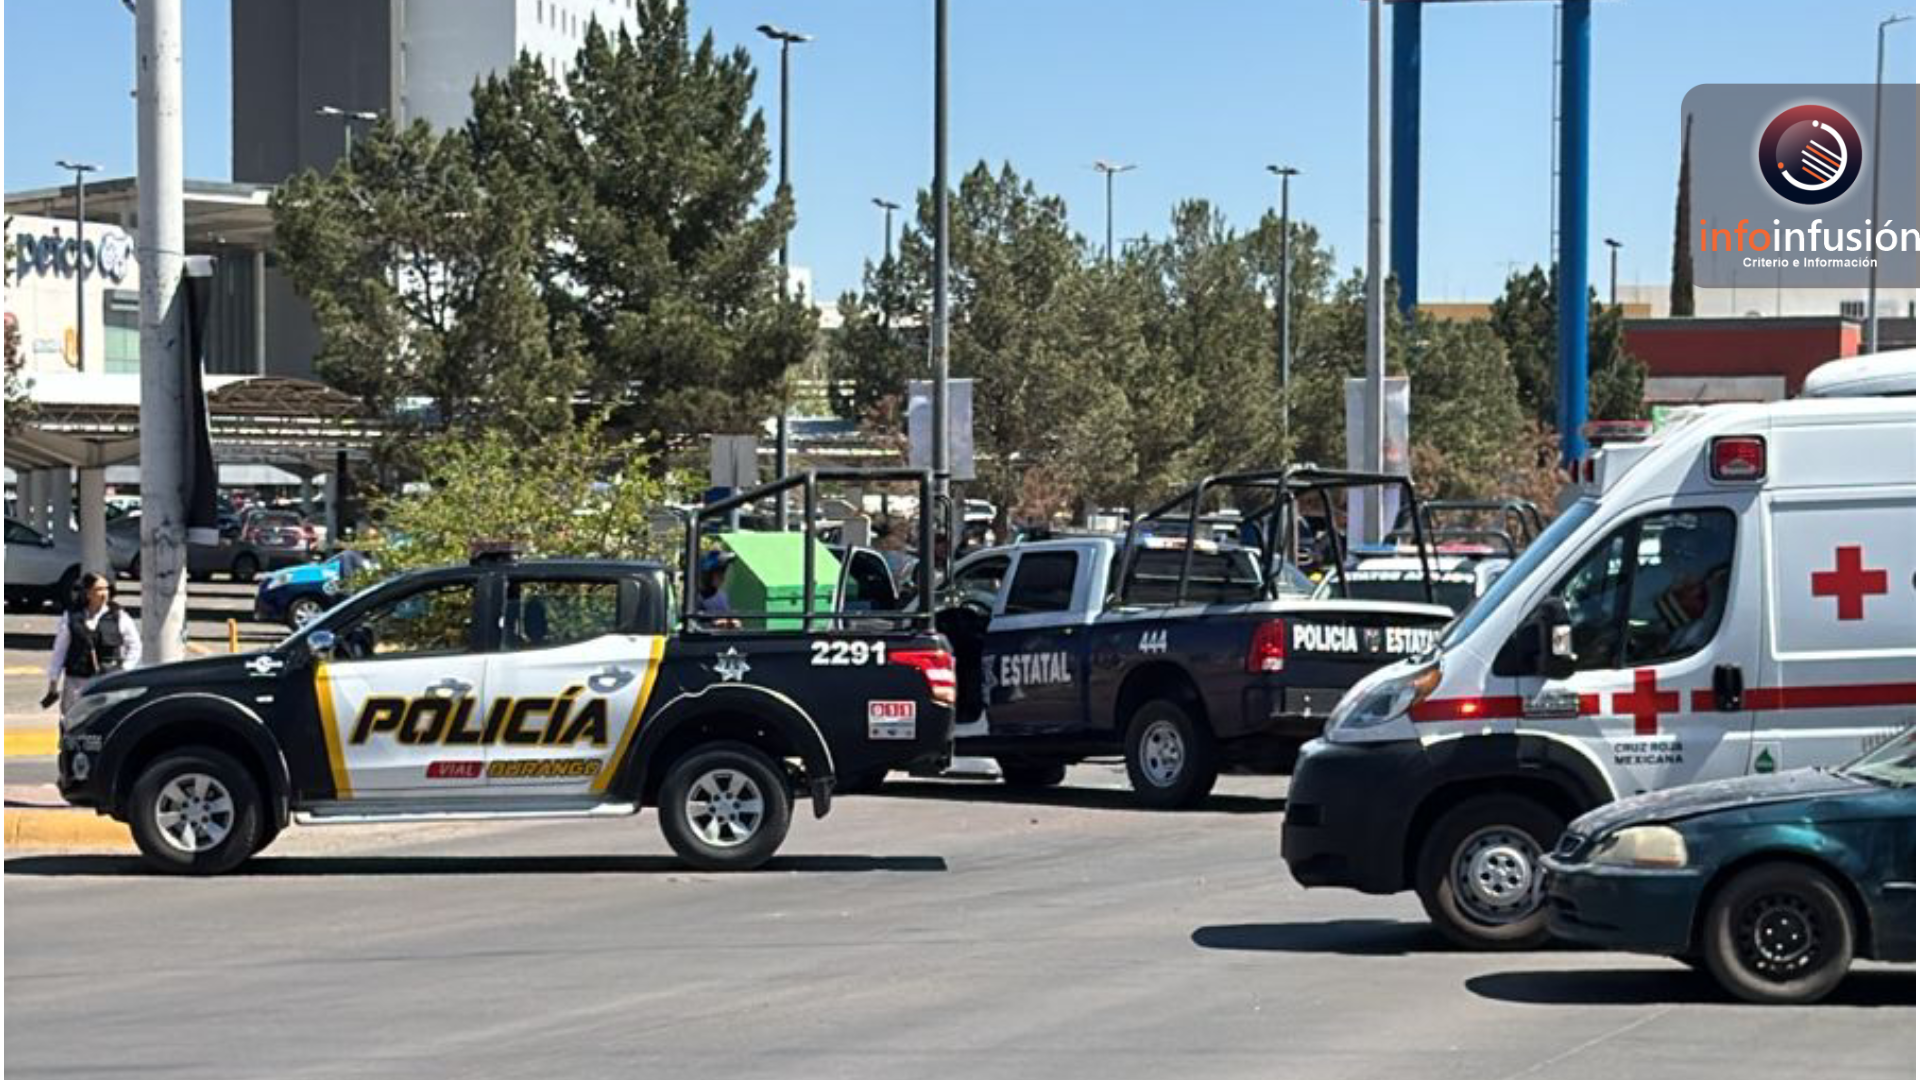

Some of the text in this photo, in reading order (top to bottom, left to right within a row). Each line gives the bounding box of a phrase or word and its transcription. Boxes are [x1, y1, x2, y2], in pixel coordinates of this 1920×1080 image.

[16, 227, 96, 287] petco
[1139, 629, 1168, 653] 444
[810, 641, 886, 666] 2291
[1001, 652, 1072, 687] ESTATAL
[350, 685, 608, 746] POLICÍA
[1614, 741, 1683, 753] CRUZ ROJA
[1614, 754, 1684, 764] MEXICANA
[436, 759, 602, 777] VIAL DURANGO
